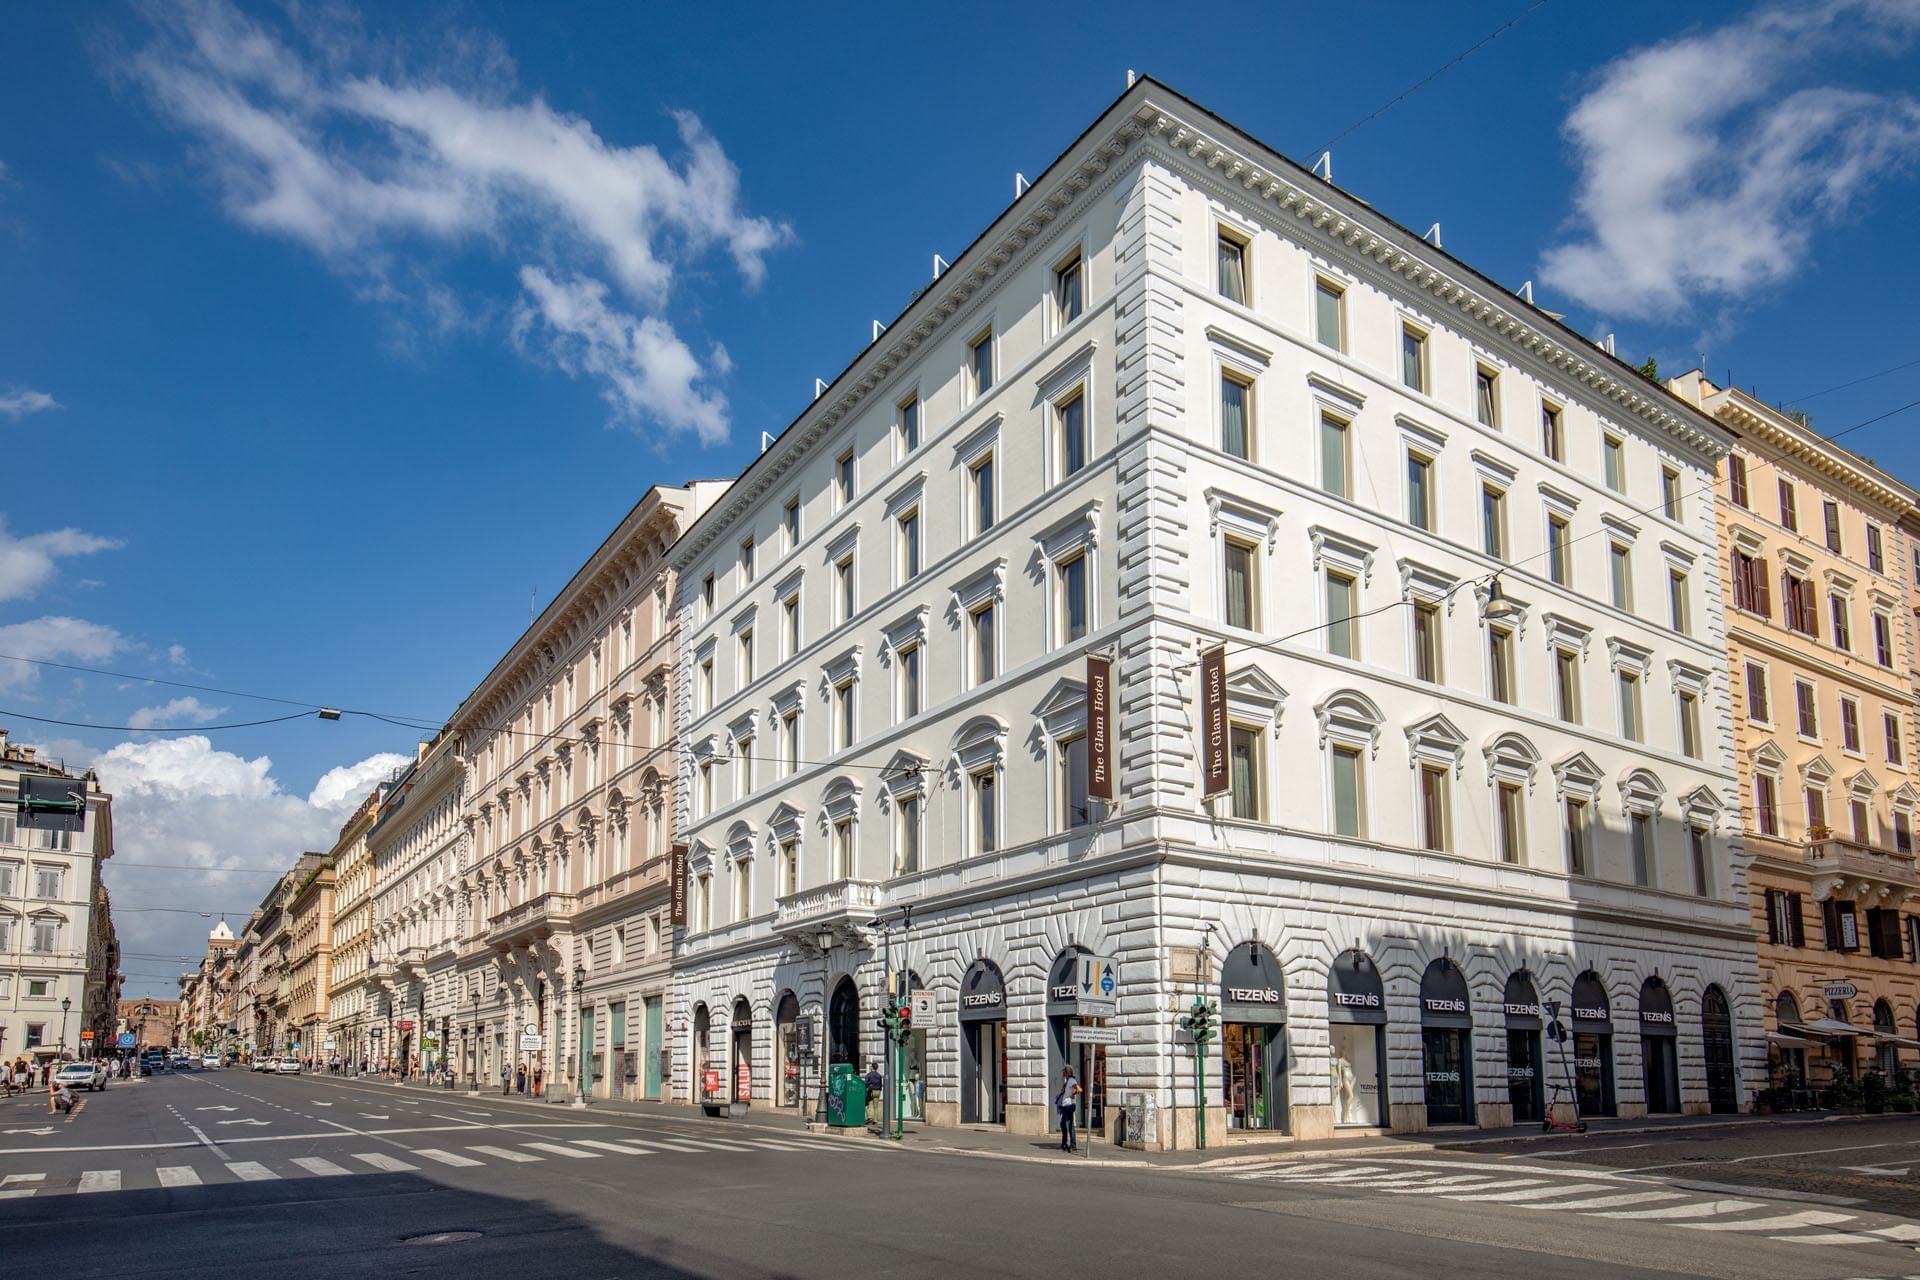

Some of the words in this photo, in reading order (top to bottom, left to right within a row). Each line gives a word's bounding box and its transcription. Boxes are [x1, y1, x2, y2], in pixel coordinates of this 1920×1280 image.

[1209, 666, 1220, 704] Hotel
[1094, 675, 1104, 712] Hotel
[1094, 716, 1105, 753] Glam
[1211, 707, 1222, 746] Glam
[1095, 757, 1105, 783] The
[1212, 749, 1222, 778] The
[675, 854, 685, 876] Hotel
[675, 878, 684, 900] Glam
[675, 901, 684, 917] The
[963, 990, 1001, 1006] TEZENIS
[1228, 986, 1279, 1002] TEZENIS
[1824, 985, 1854, 997] PIZZERIA
[1334, 992, 1380, 1007] TEZENIS
[1425, 998, 1466, 1012] TEZENIS
[1503, 1002, 1540, 1016] TEZENIS
[1574, 1006, 1607, 1019] TEZENIS
[1641, 1010, 1673, 1023] TEZENIS
[738, 1066, 750, 1096] SALDI
[1426, 1070, 1460, 1082] TEZENIS
